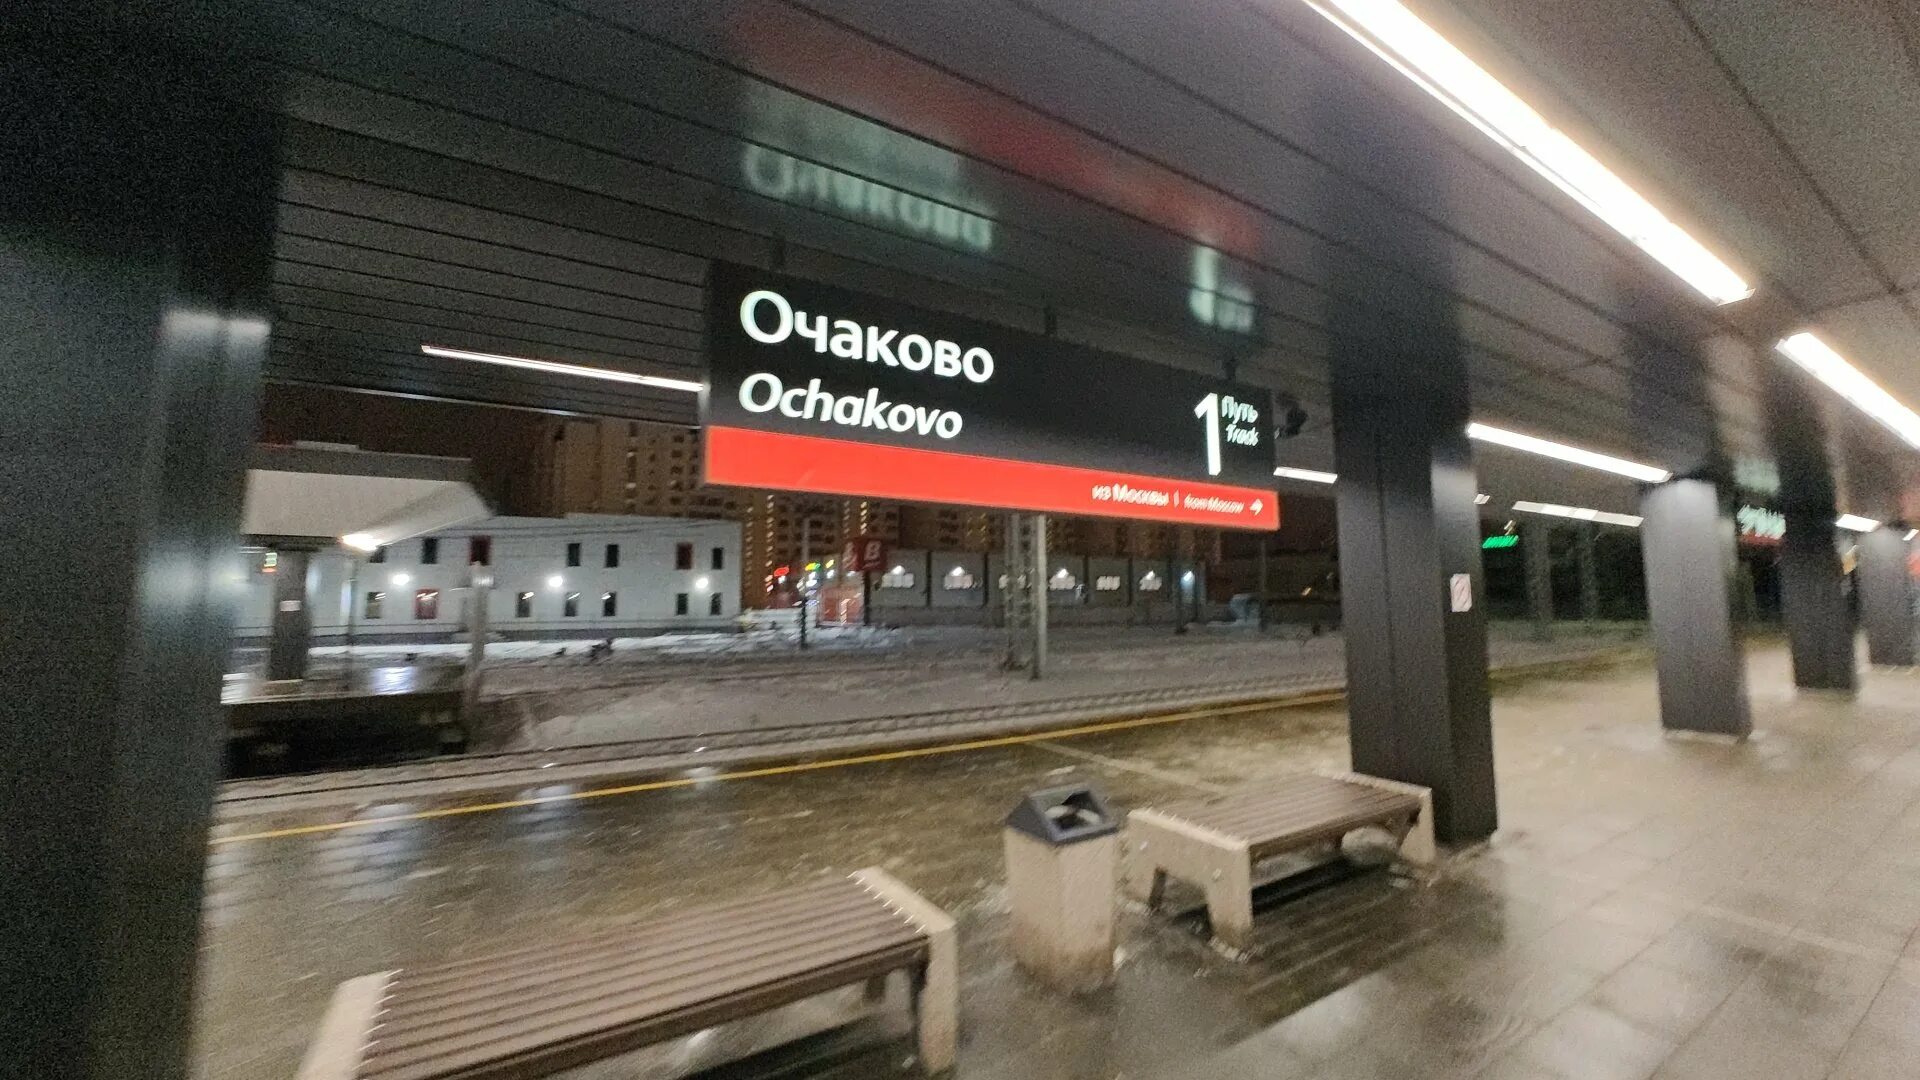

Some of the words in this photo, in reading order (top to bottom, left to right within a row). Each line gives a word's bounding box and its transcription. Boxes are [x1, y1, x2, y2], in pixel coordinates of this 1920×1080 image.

[740, 290, 994, 383] Очаково
[739, 372, 963, 439] Ochakovo
[1194, 392, 1221, 476] 1
